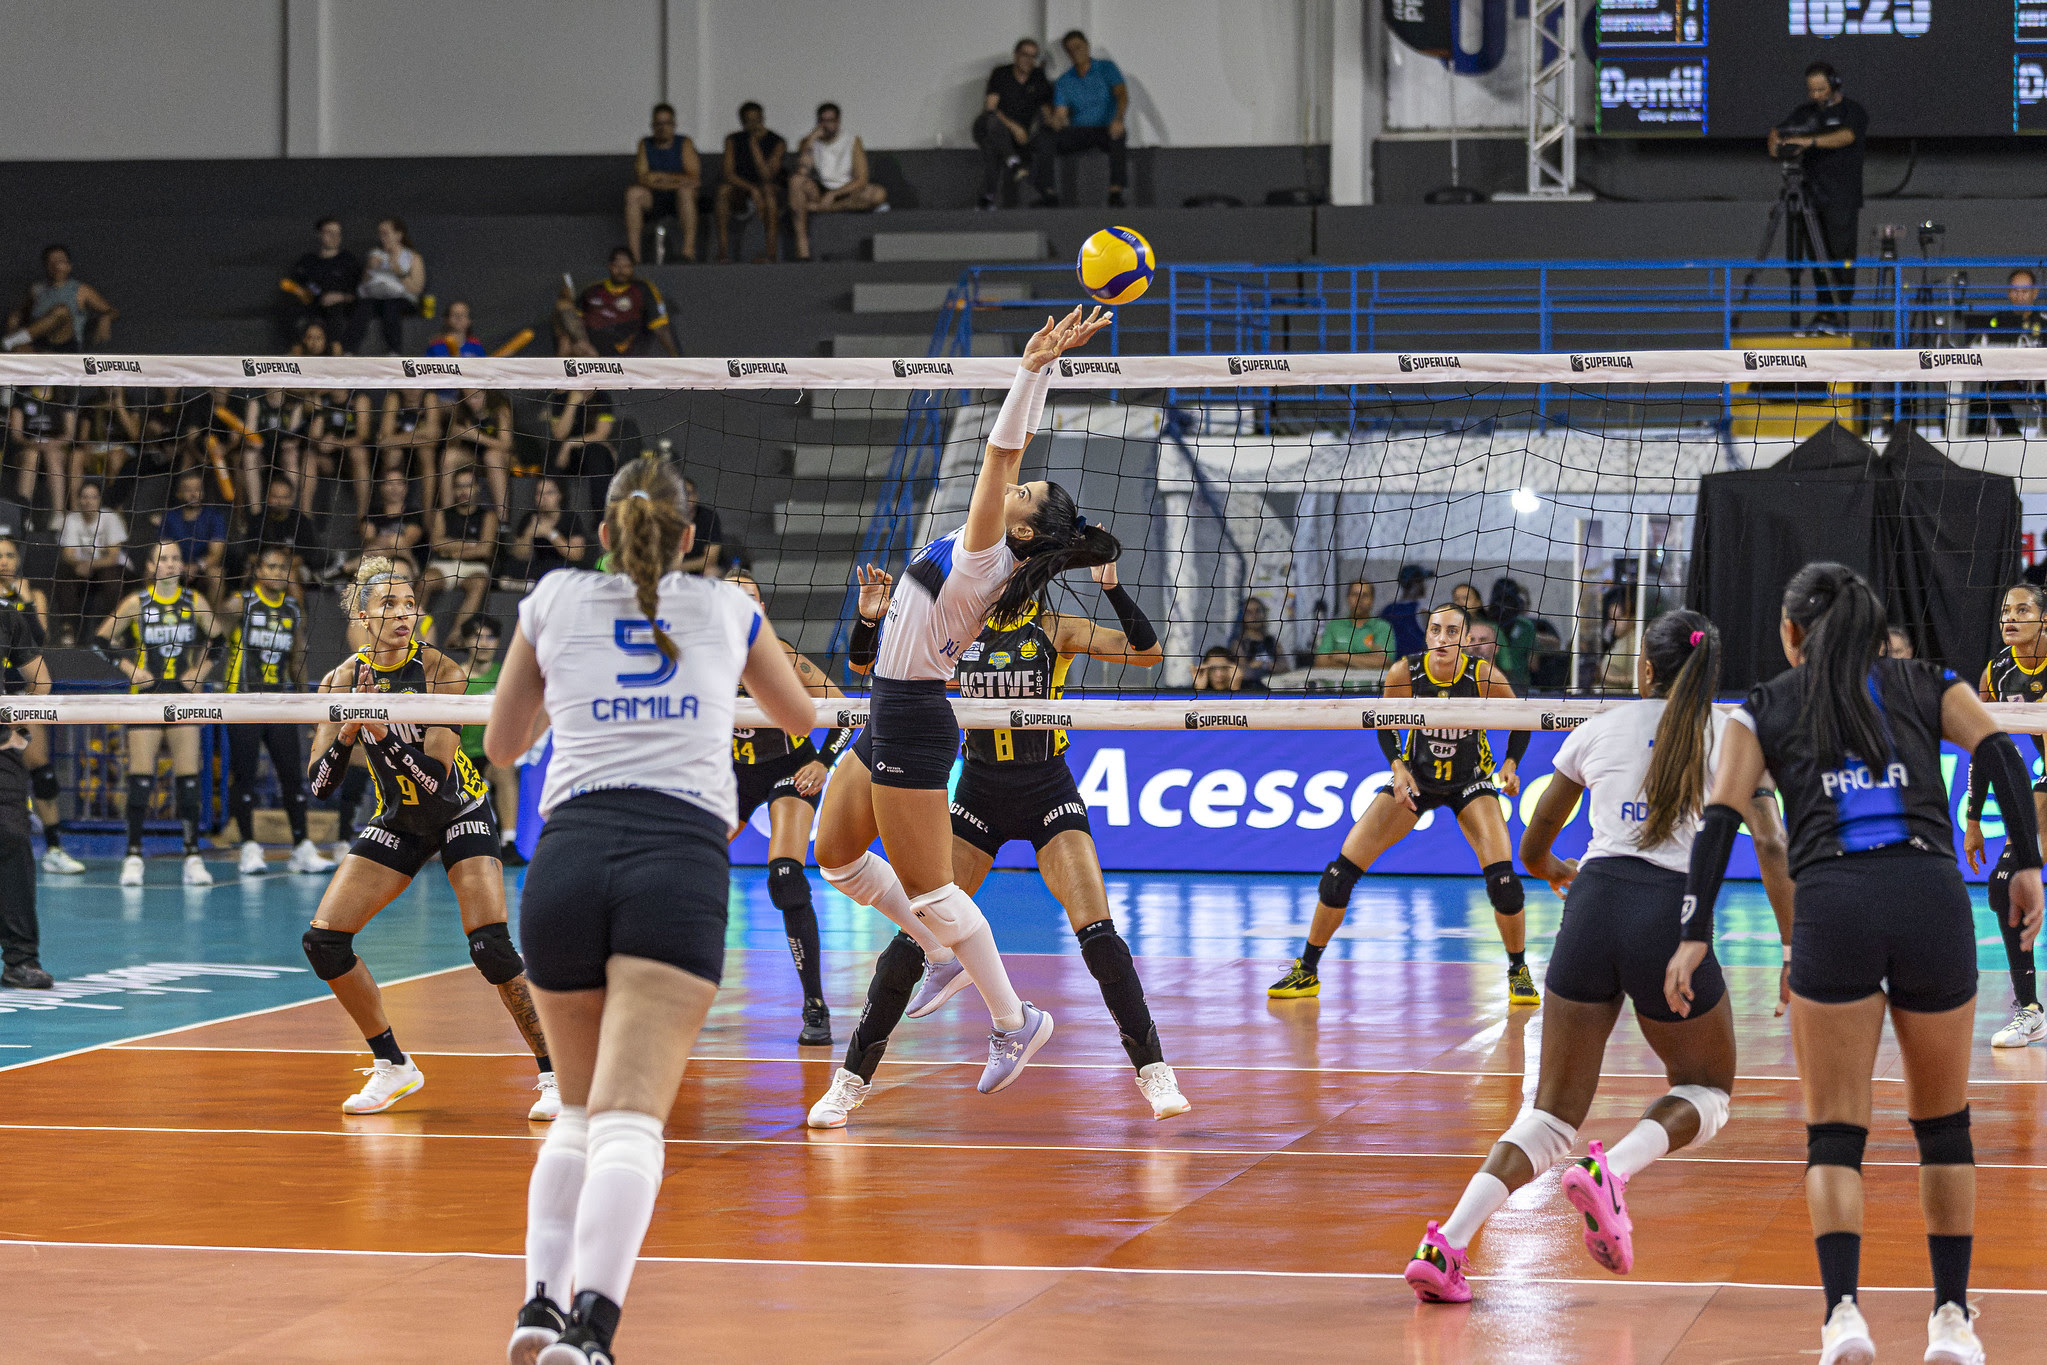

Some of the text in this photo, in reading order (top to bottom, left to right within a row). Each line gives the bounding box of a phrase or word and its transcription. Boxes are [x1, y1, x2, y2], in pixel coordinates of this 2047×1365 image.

[1600, 66, 1702, 108] Dentil
[96, 360, 142, 374] SUPERLIGA
[1242, 359, 1290, 373] SUPERLIGA
[1413, 356, 1461, 370] SUPERLIGA
[1585, 356, 1633, 370] SUPERLIGA
[1758, 355, 1807, 369] SUPERLIGA
[1933, 353, 1983, 368] SUPERLIGA
[255, 362, 301, 376] SUPERLIGA
[415, 363, 462, 377] SUPERLIGA
[577, 362, 624, 376] SUPERLIGA
[740, 362, 788, 376] SUPERLIGA
[905, 362, 954, 377] SUPERLIGA
[1074, 361, 1121, 375] SUPERLIGA
[614, 619, 678, 688] 5
[960, 670, 1035, 698] ACTIVE
[13, 709, 58, 722] SUPERLIGA
[176, 708, 223, 721] SUPERLIGA
[342, 708, 389, 721] SUPERLIGA
[592, 695, 699, 722] CAMILA
[1024, 714, 1072, 727] SUPERLIGA
[1199, 714, 1248, 728] SUPERLIGA
[1376, 713, 1426, 727] SUPERLIGA
[994, 729, 1015, 761] 8
[1433, 746, 1452, 755] BH
[402, 753, 439, 793] Dentil
[1433, 760, 1453, 781] 11
[395, 775, 420, 805] 9
[446, 821, 487, 844] ACTIVE
